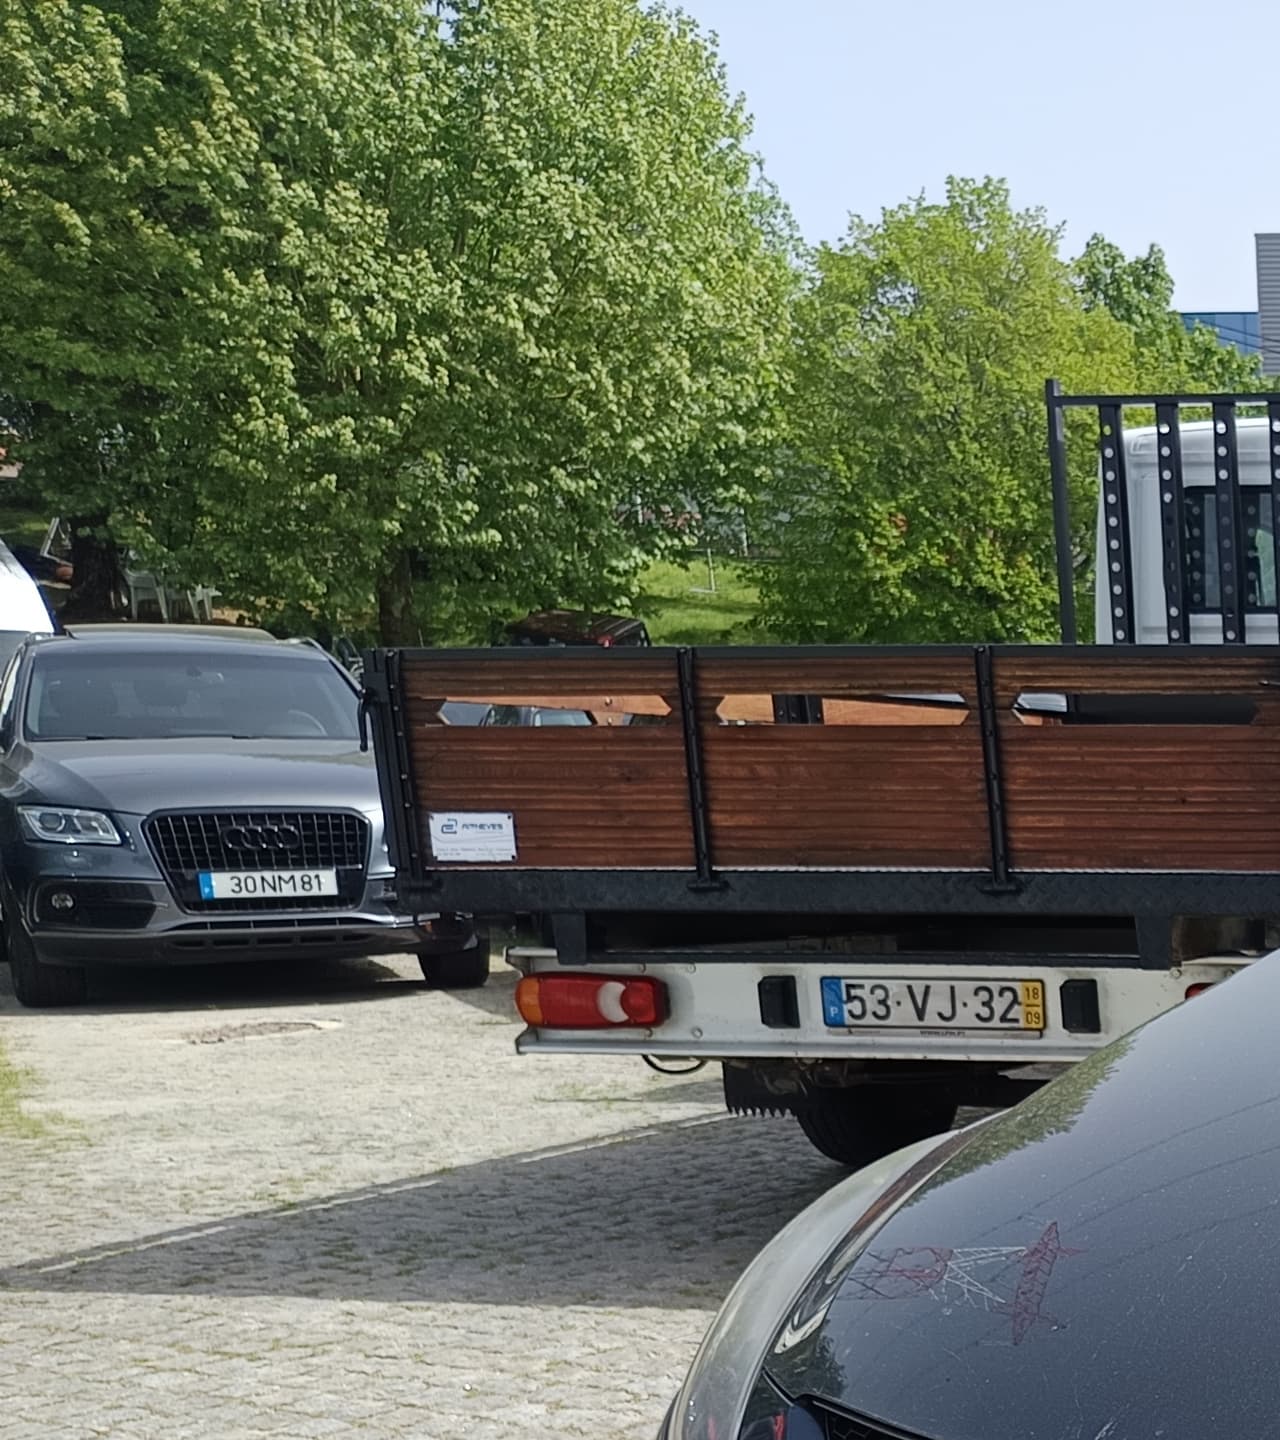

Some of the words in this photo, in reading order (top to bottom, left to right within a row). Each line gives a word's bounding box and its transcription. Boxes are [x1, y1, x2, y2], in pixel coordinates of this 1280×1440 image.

[1025, 987, 1040, 999] 18
[830, 1007, 839, 1017] P
[1026, 1012, 1041, 1025] 09
